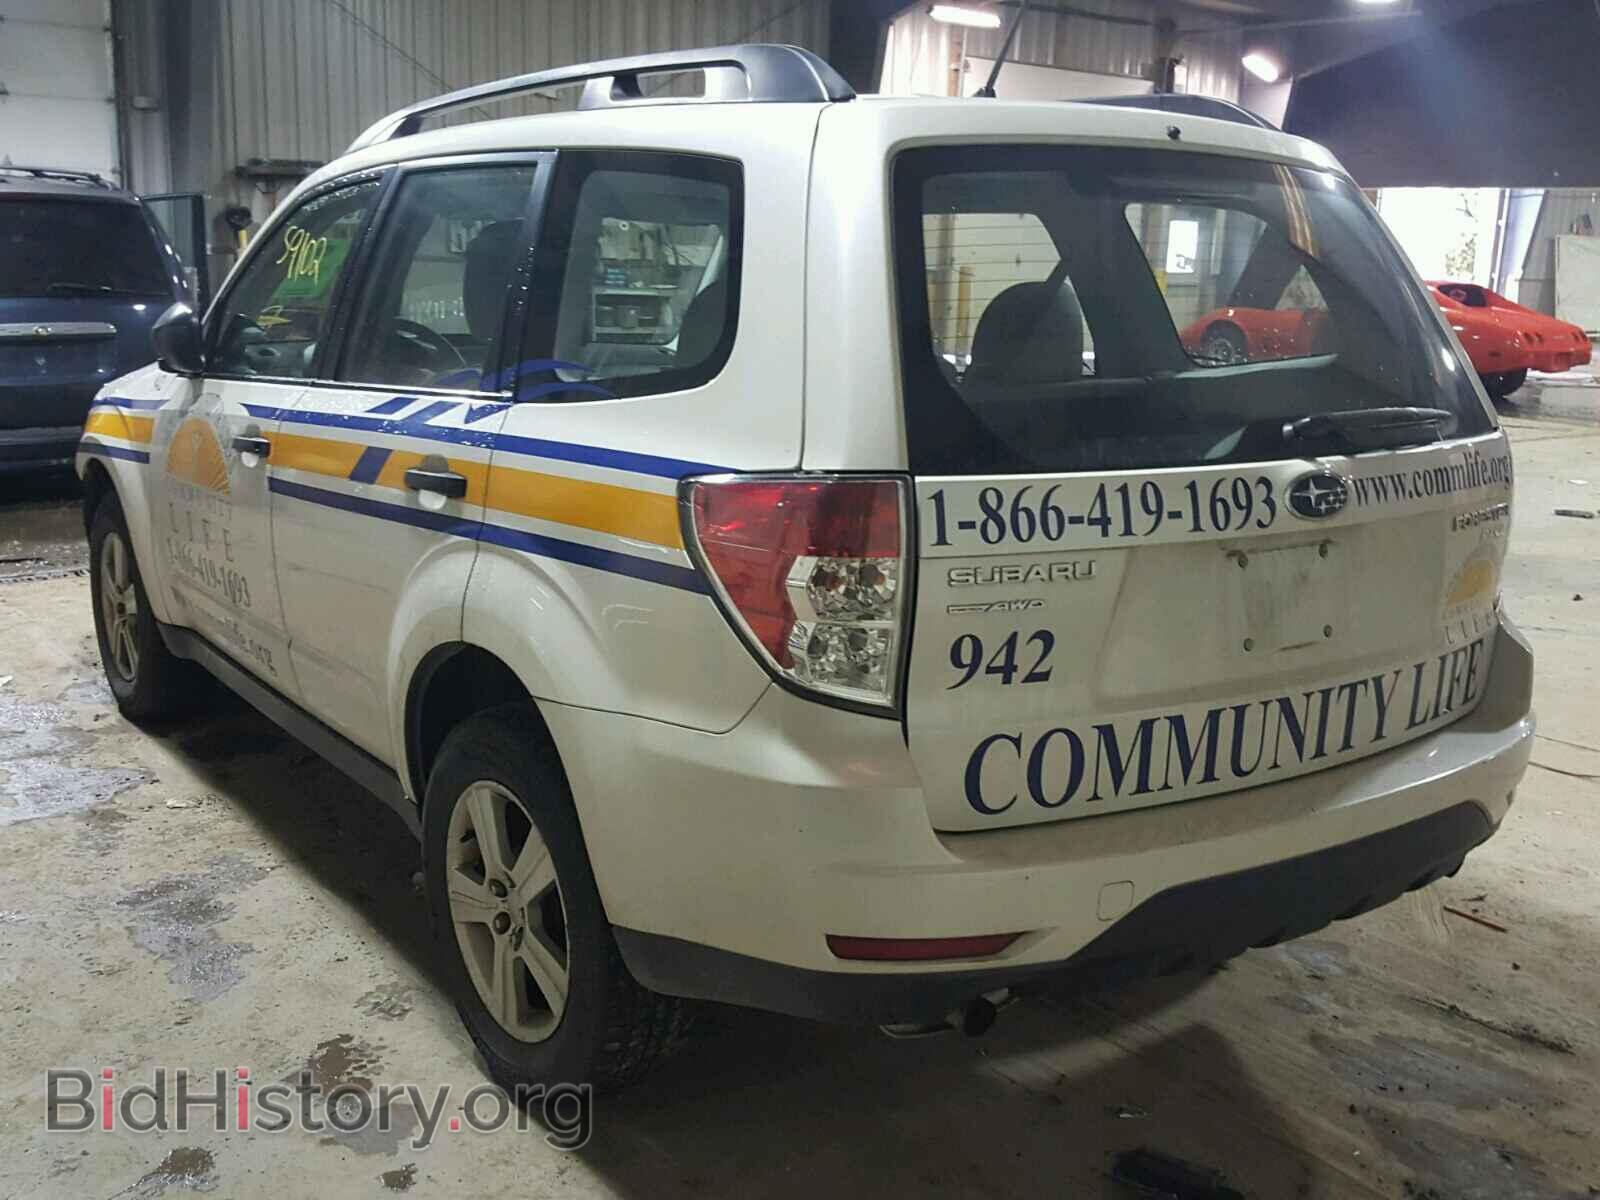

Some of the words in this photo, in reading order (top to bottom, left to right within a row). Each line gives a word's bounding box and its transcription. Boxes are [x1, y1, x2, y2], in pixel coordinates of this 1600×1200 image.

[1353, 450, 1513, 508] www.commlife.org
[927, 475, 1277, 547] 1-866-419-1693
[948, 560, 1097, 587] SUBARU
[946, 629, 1056, 690] 942
[964, 669, 1401, 816] COMMUNITY
[1406, 638, 1484, 731] LIFE
